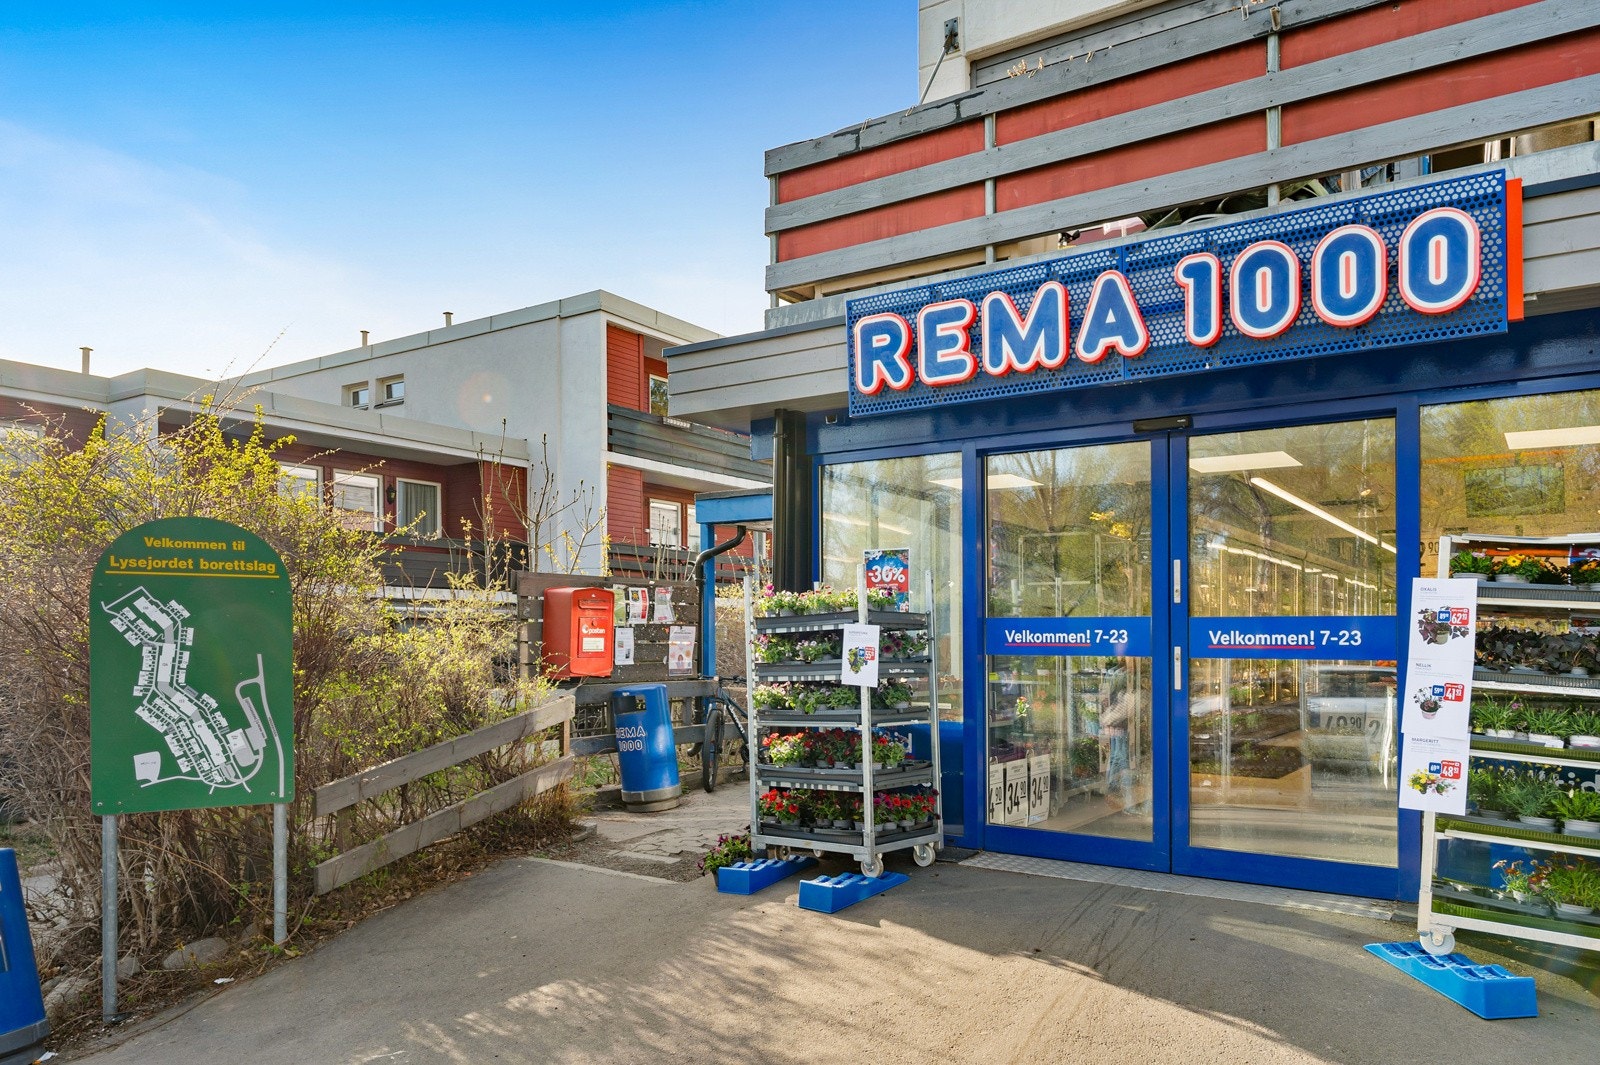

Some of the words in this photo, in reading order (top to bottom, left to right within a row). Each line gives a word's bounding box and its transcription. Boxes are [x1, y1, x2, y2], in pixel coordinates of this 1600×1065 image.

[853, 270, 1150, 396] REMA
[1174, 206, 1481, 348] 1000
[144, 536, 227, 551] Velkommen
[232, 541, 246, 551] til
[110, 555, 194, 570] Lysejordet
[200, 558, 276, 574] borettslag
[1005, 629, 1091, 644] Velkommen!
[1094, 630, 1129, 644] 7-23
[1208, 630, 1315, 645] Velkommen!
[1320, 630, 1362, 646] 7-23
